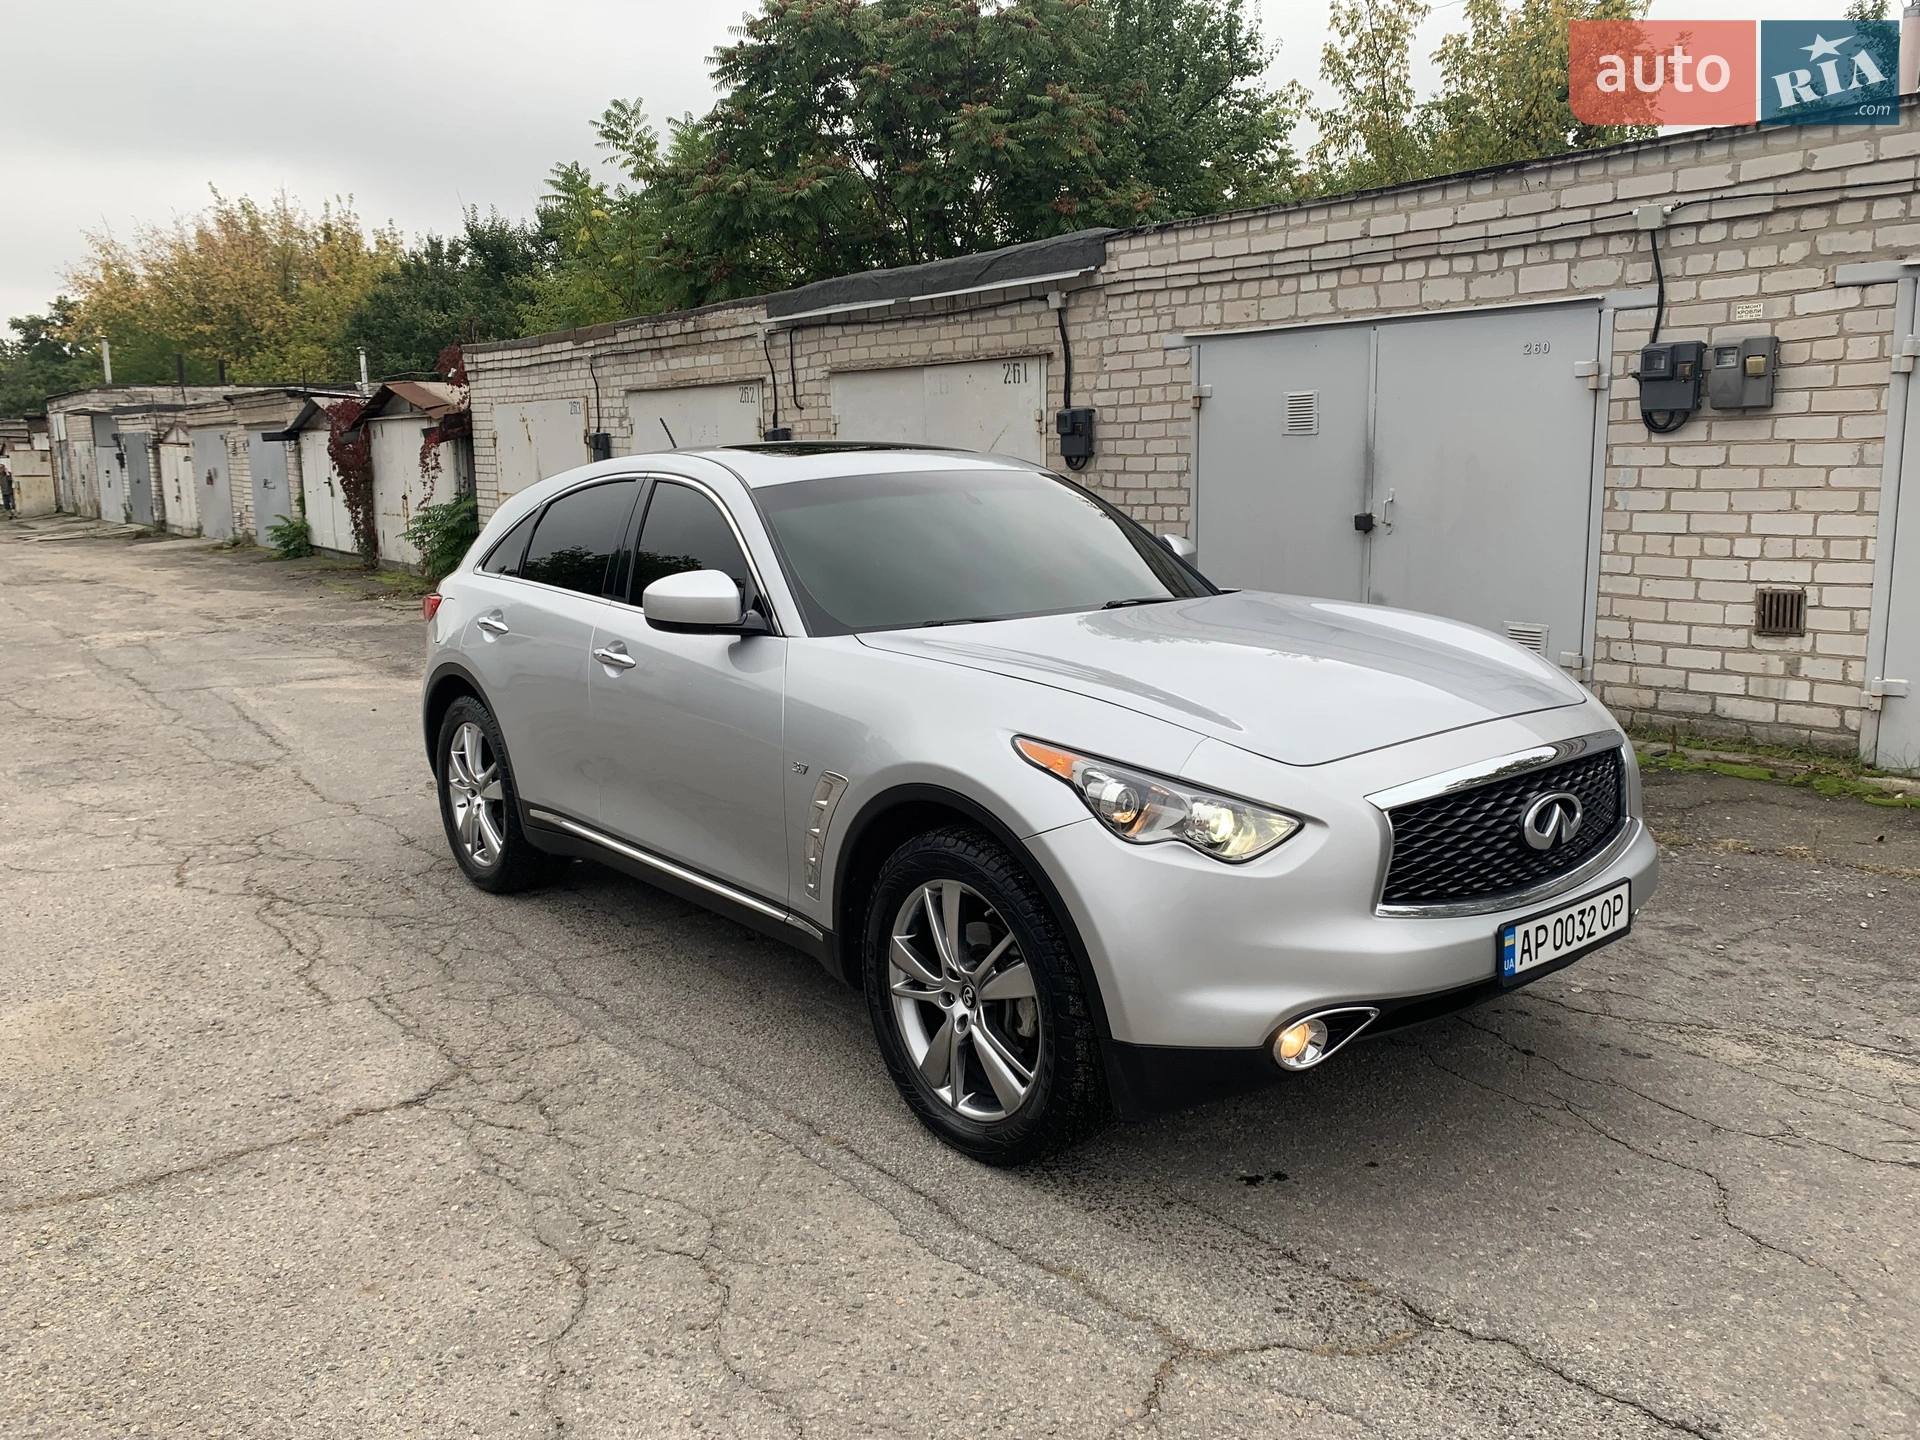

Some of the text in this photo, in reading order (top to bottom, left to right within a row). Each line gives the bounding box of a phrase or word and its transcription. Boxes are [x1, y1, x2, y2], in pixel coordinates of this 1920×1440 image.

[1523, 341, 1551, 355] 260
[1002, 362, 1027, 385] 261
[739, 386, 756, 404] 262
[1519, 893, 1624, 966] AP 0032 OP
[1504, 960, 1514, 970] UA
